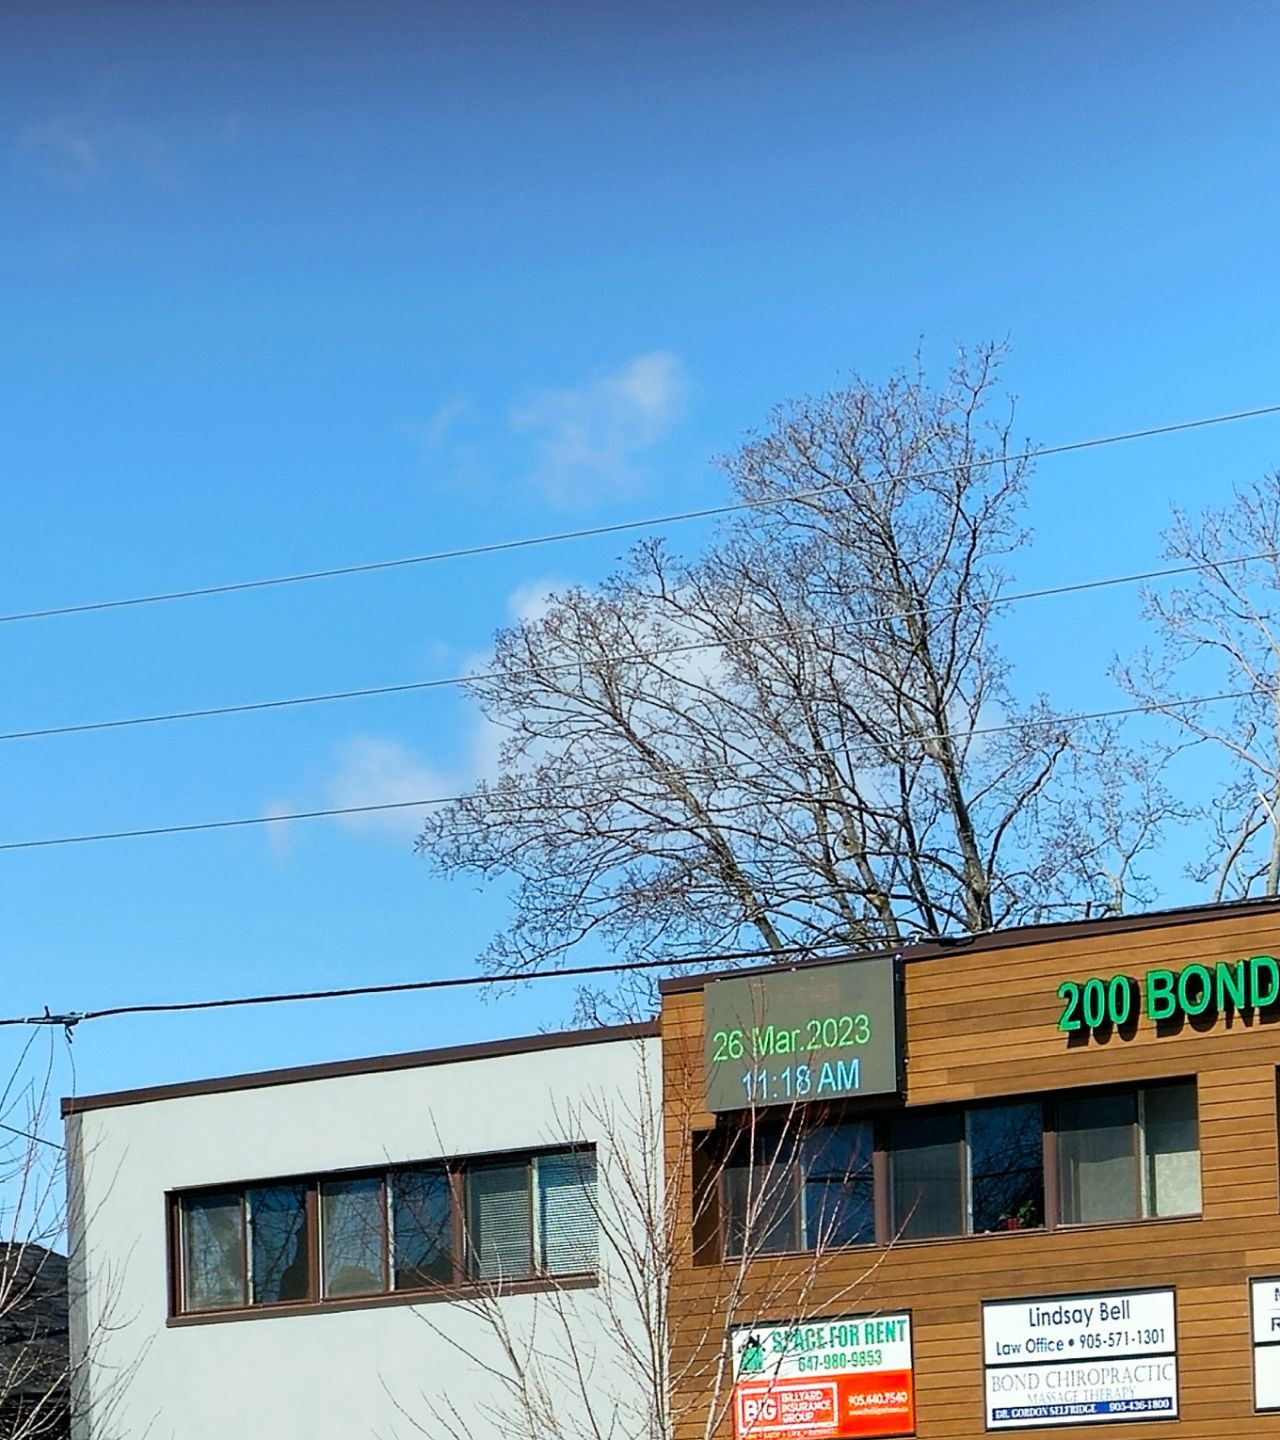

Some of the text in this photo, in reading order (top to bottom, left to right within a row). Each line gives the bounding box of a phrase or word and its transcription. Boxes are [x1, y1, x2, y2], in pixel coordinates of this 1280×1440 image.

[1057, 974, 1131, 1031] 200
[1147, 956, 1280, 1020] BOND
[713, 1014, 871, 1061] 26 Mar.2023
[742, 1058, 860, 1100] 11:18 AM
[1029, 1300, 1130, 1328] Lindsay Bell
[830, 1323, 861, 1348] FOR
[864, 1319, 907, 1345] RENT
[996, 1328, 1166, 1356] Law Office 905-571-1301
[798, 1350, 883, 1373] 647-980-9853
[991, 1363, 1174, 1392] BOND CHIROPRACTIC
[744, 1398, 778, 1421] BIG
[781, 1399, 833, 1414] INSURANCE
[1027, 1386, 1137, 1405] MASSAGE THERAPY
[782, 1411, 815, 1424] GROUP
[995, 1408, 1010, 1420] DR.
[1011, 1406, 1048, 1418] GORDON
[1050, 1404, 1097, 1416] SELFRIDGE
